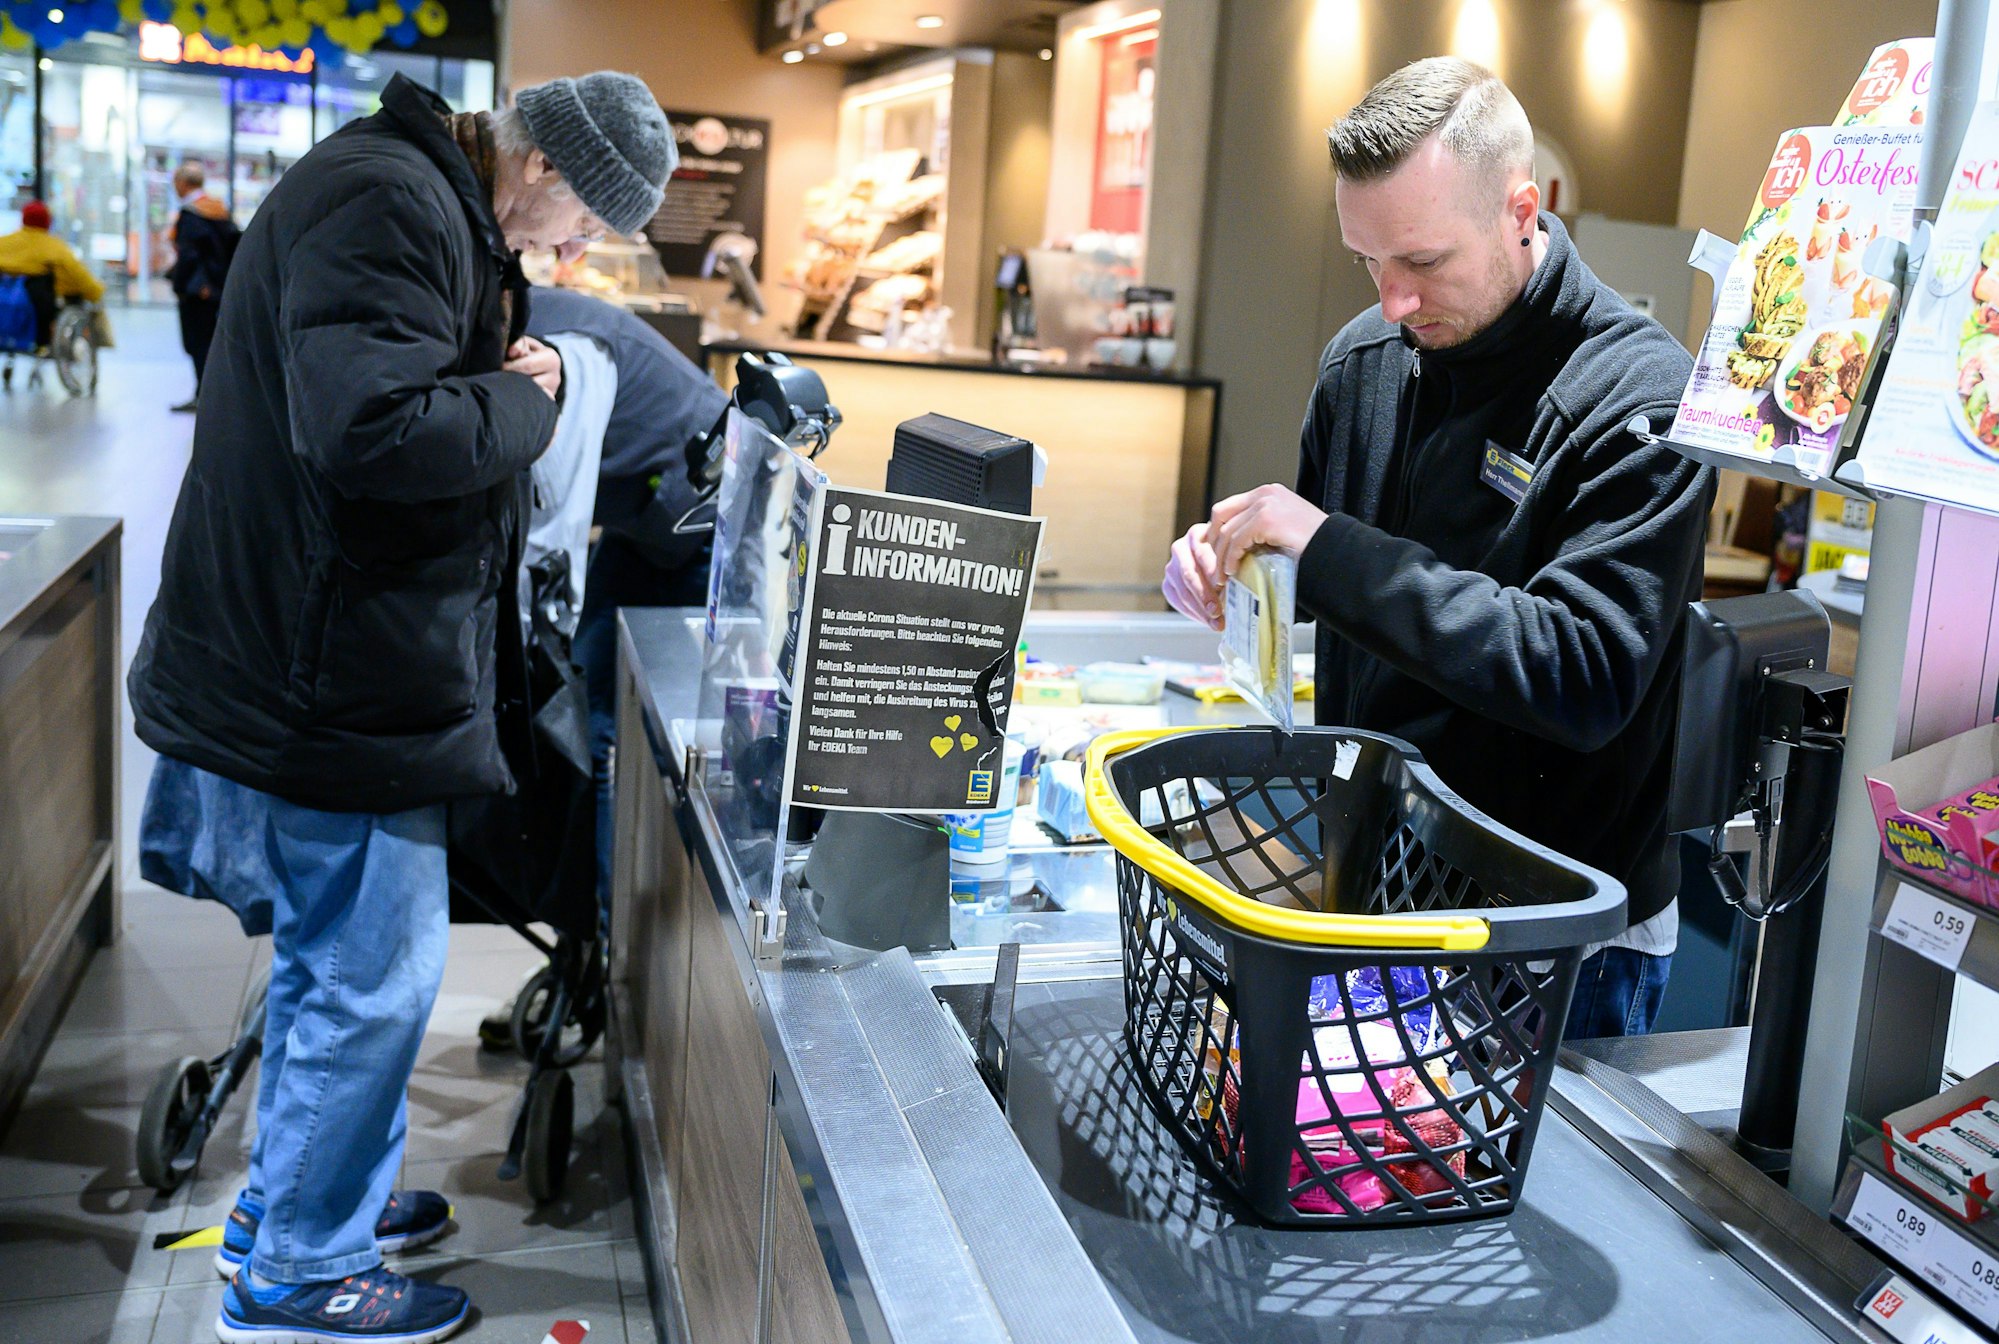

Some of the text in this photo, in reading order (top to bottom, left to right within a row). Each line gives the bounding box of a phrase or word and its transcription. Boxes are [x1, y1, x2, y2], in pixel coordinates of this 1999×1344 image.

[1956, 160, 1999, 191] SC
[1679, 402, 1764, 434] Traumkuchen
[857, 508, 967, 550] KUNDEN-
[851, 546, 1024, 597] INFORMATION!
[822, 608, 1005, 635] Die aktuelle Corona Situation stellt uns vor große
[818, 638, 853, 652] Hinweis:
[820, 623, 1003, 648] Herausforderungen. Bitte beachten Sie folgenden
[816, 659, 842, 672] Halten
[843, 661, 856, 673] Sie
[856, 663, 901, 675] mindestens
[901, 665, 917, 677] 1,50
[917, 667, 926, 677] m
[926, 666, 957, 679] Abstand
[815, 675, 830, 686] ein.
[830, 675, 854, 688] Damit
[855, 678, 895, 691] verringern
[895, 679, 908, 691] Sie
[908, 680, 922, 691] das
[811, 704, 857, 719] langsamen.
[813, 691, 829, 701] und
[830, 690, 856, 703] helfen
[856, 693, 873, 705] mit,
[873, 693, 886, 705] die
[886, 694, 933, 709] Ausbreitung
[933, 696, 948, 707] des
[949, 697, 969, 708] Virus
[809, 725, 903, 741] Vielen Dank für Ihre Hilfe
[808, 740, 868, 755] Ihr EDEKA Team
[1934, 910, 1965, 935] 0,59
[1897, 1208, 1926, 1236] 0,89
[1972, 1261, 1999, 1291] 0,89
